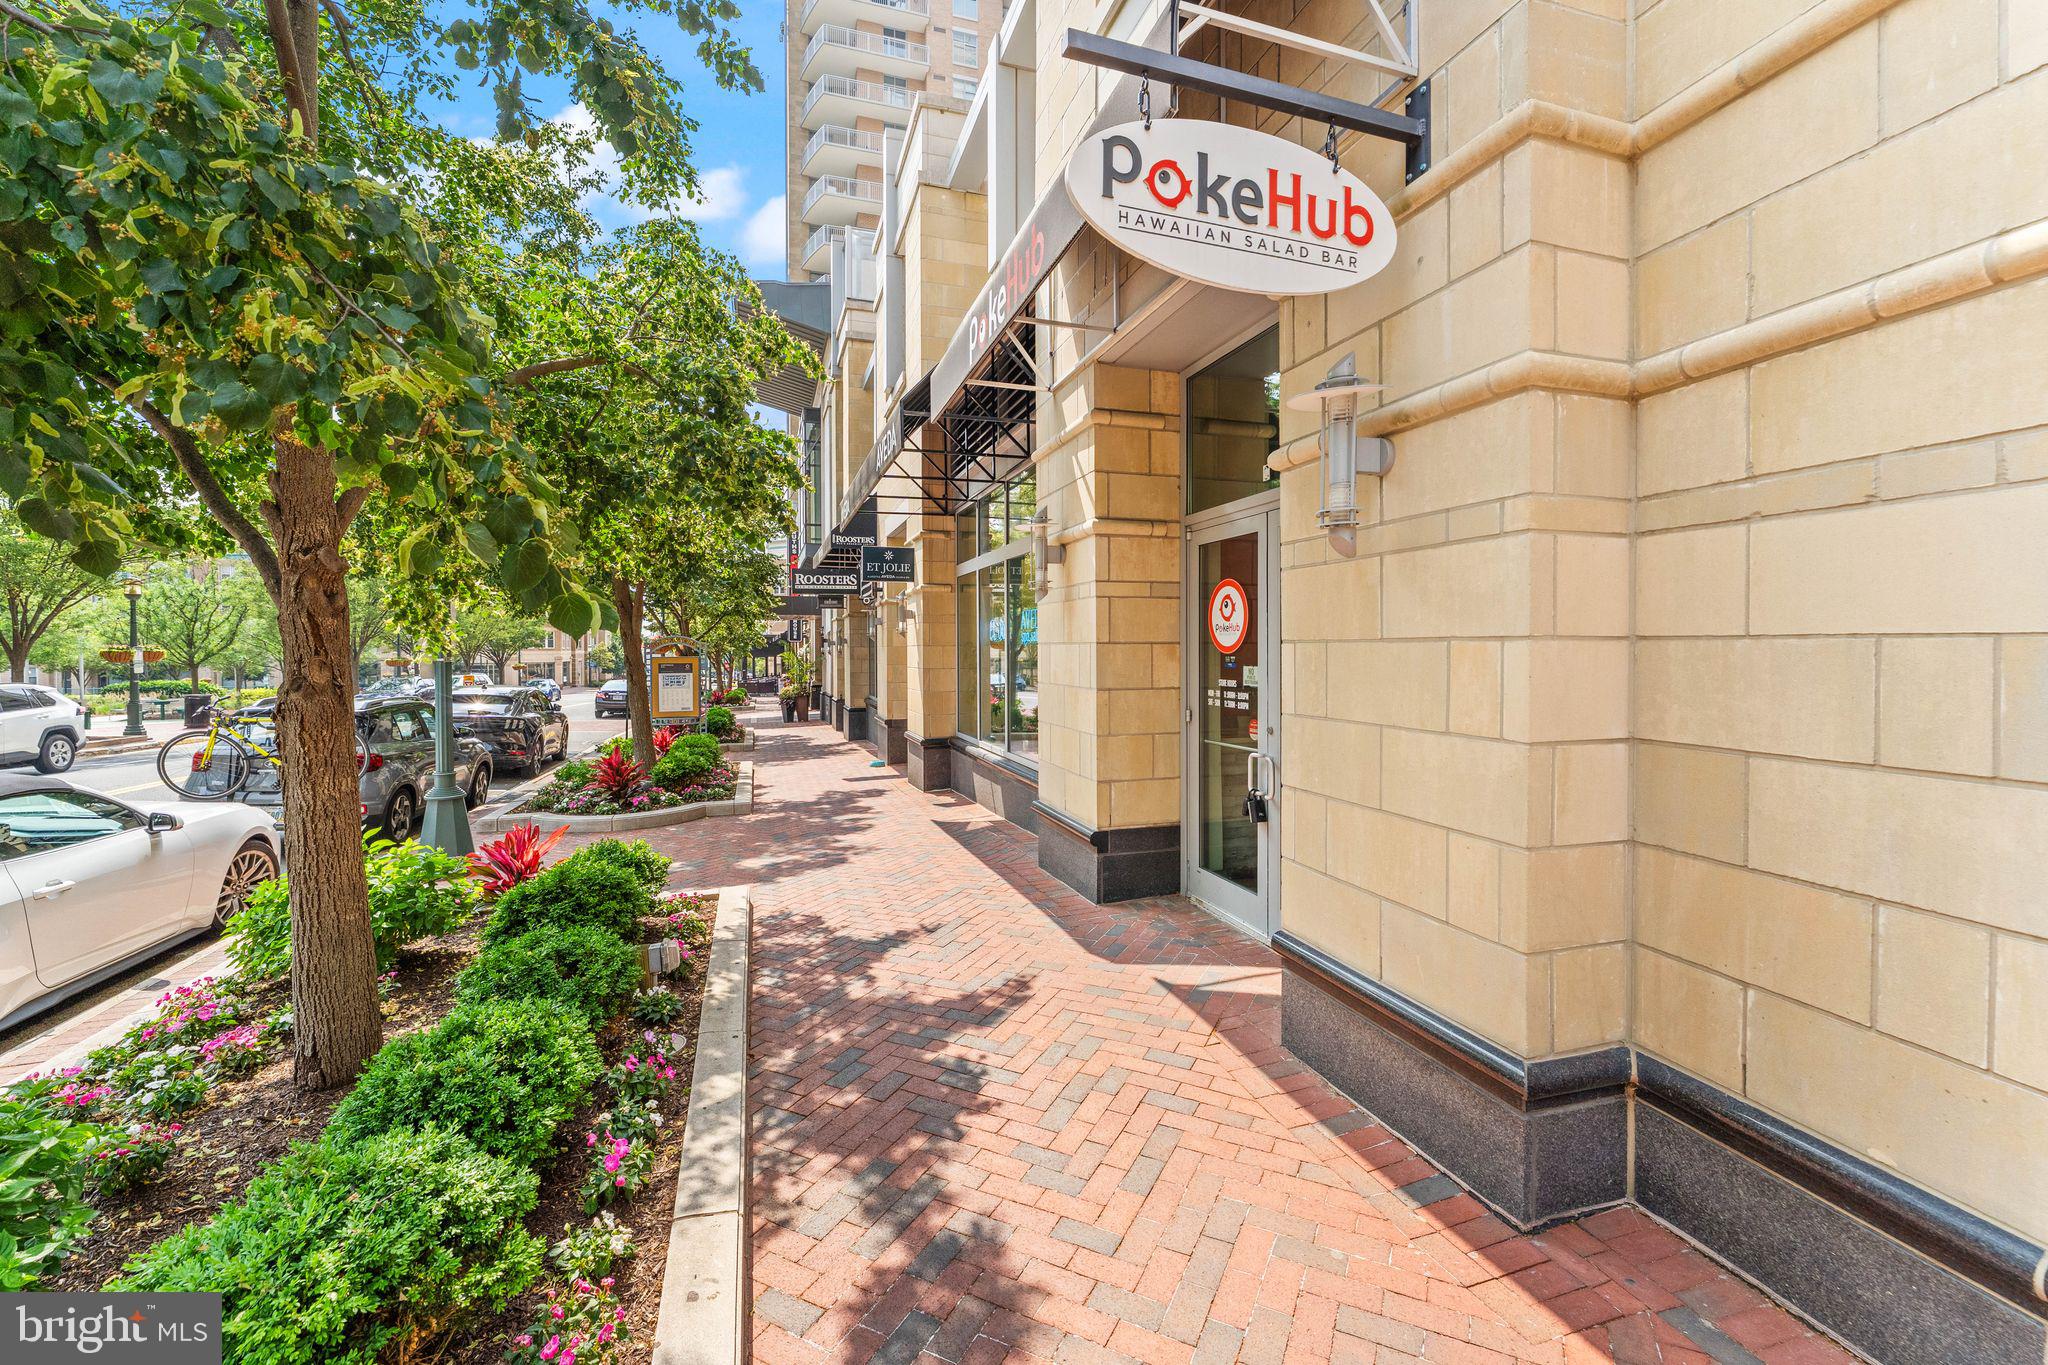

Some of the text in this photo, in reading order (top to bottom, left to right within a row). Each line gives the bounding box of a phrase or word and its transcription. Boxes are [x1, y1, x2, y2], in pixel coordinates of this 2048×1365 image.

[1102, 135, 1374, 246] PokeHub
[1118, 209, 1358, 269] HAWAIIAN SALAD BAR
[969, 223, 1045, 366] PokeHub
[875, 424, 898, 472] AVEDA
[835, 535, 876, 544] ROOSTERS
[794, 573, 858, 586] ROOSTERS
[866, 562, 912, 574] ET JOLIE
